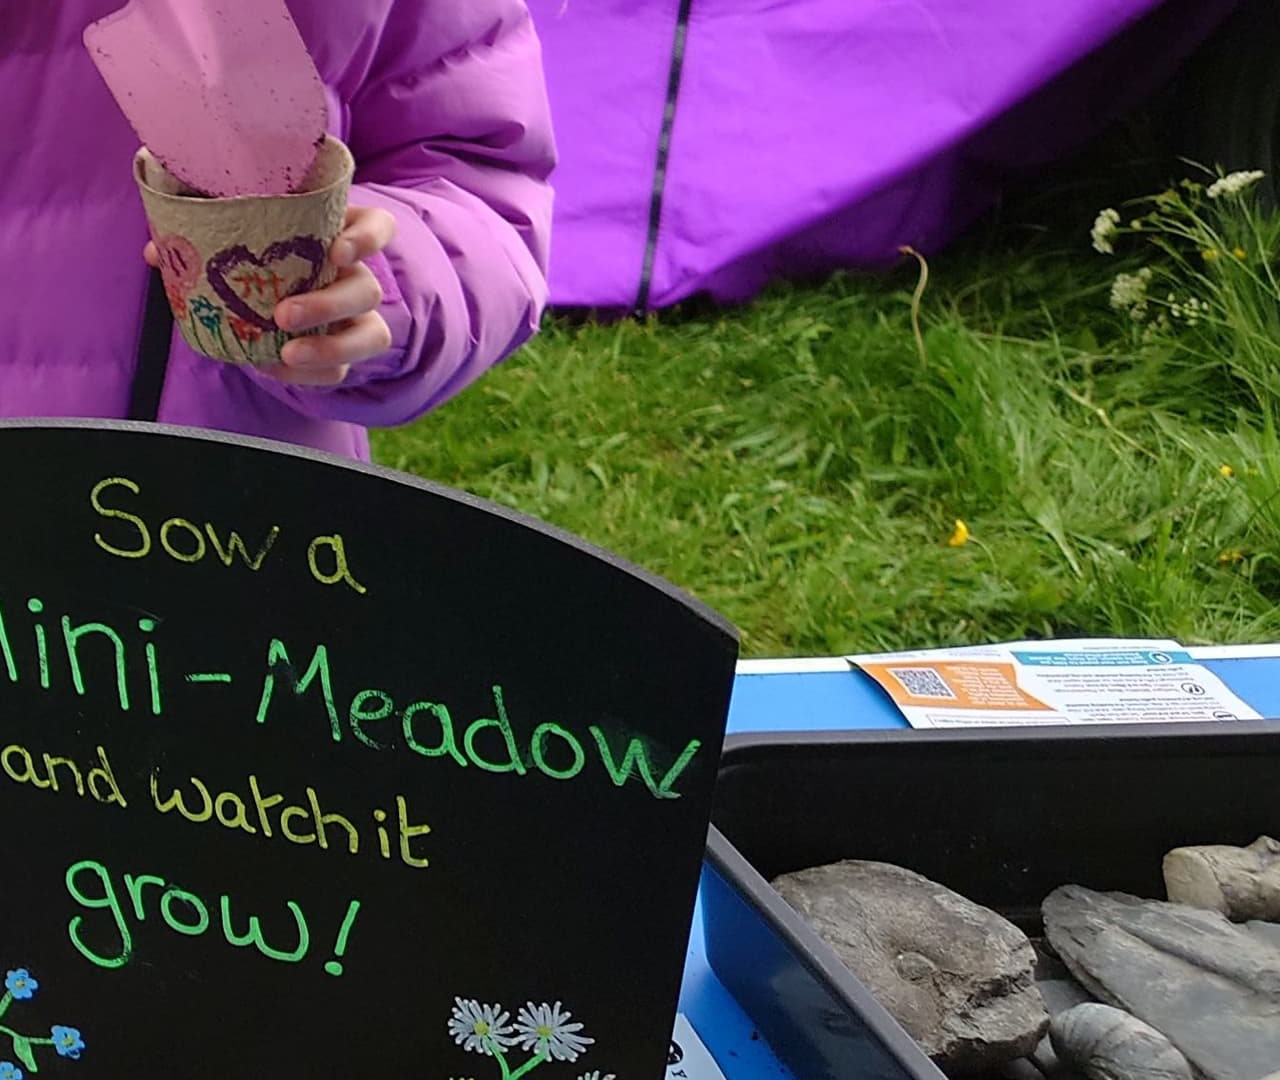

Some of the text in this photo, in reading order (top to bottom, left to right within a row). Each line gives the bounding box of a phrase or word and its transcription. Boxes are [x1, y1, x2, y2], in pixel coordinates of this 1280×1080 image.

[91, 477, 368, 595] Sow a
[0, 744, 128, 809] and
[64, 859, 362, 978] grow!
